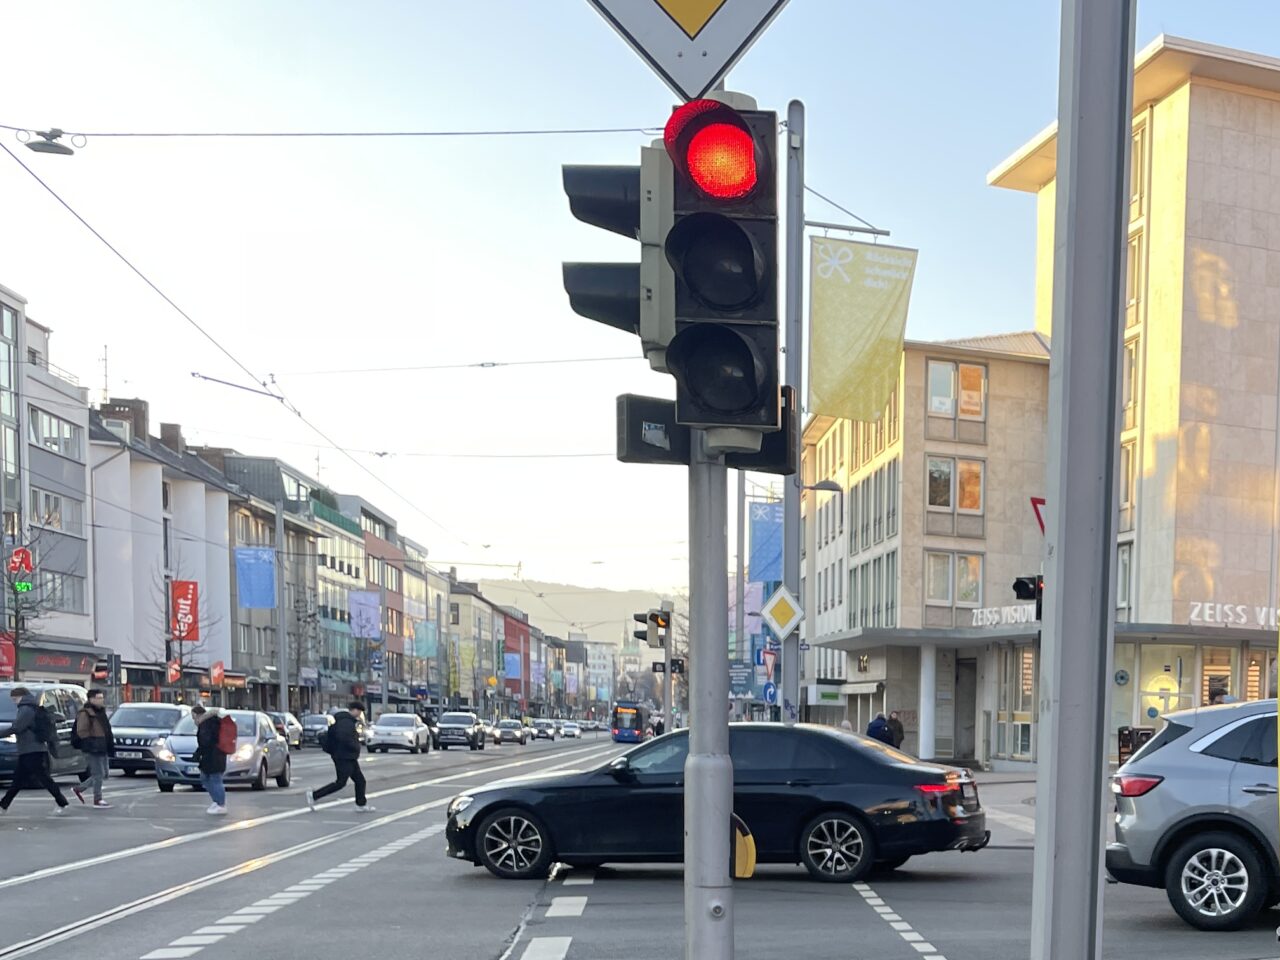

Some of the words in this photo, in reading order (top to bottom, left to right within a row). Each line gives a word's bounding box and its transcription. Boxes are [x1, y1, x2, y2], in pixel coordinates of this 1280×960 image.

[972, 607, 1000, 626] ZEISS
[1001, 604, 1037, 624] VISION
[1190, 601, 1248, 625] ZEISS
